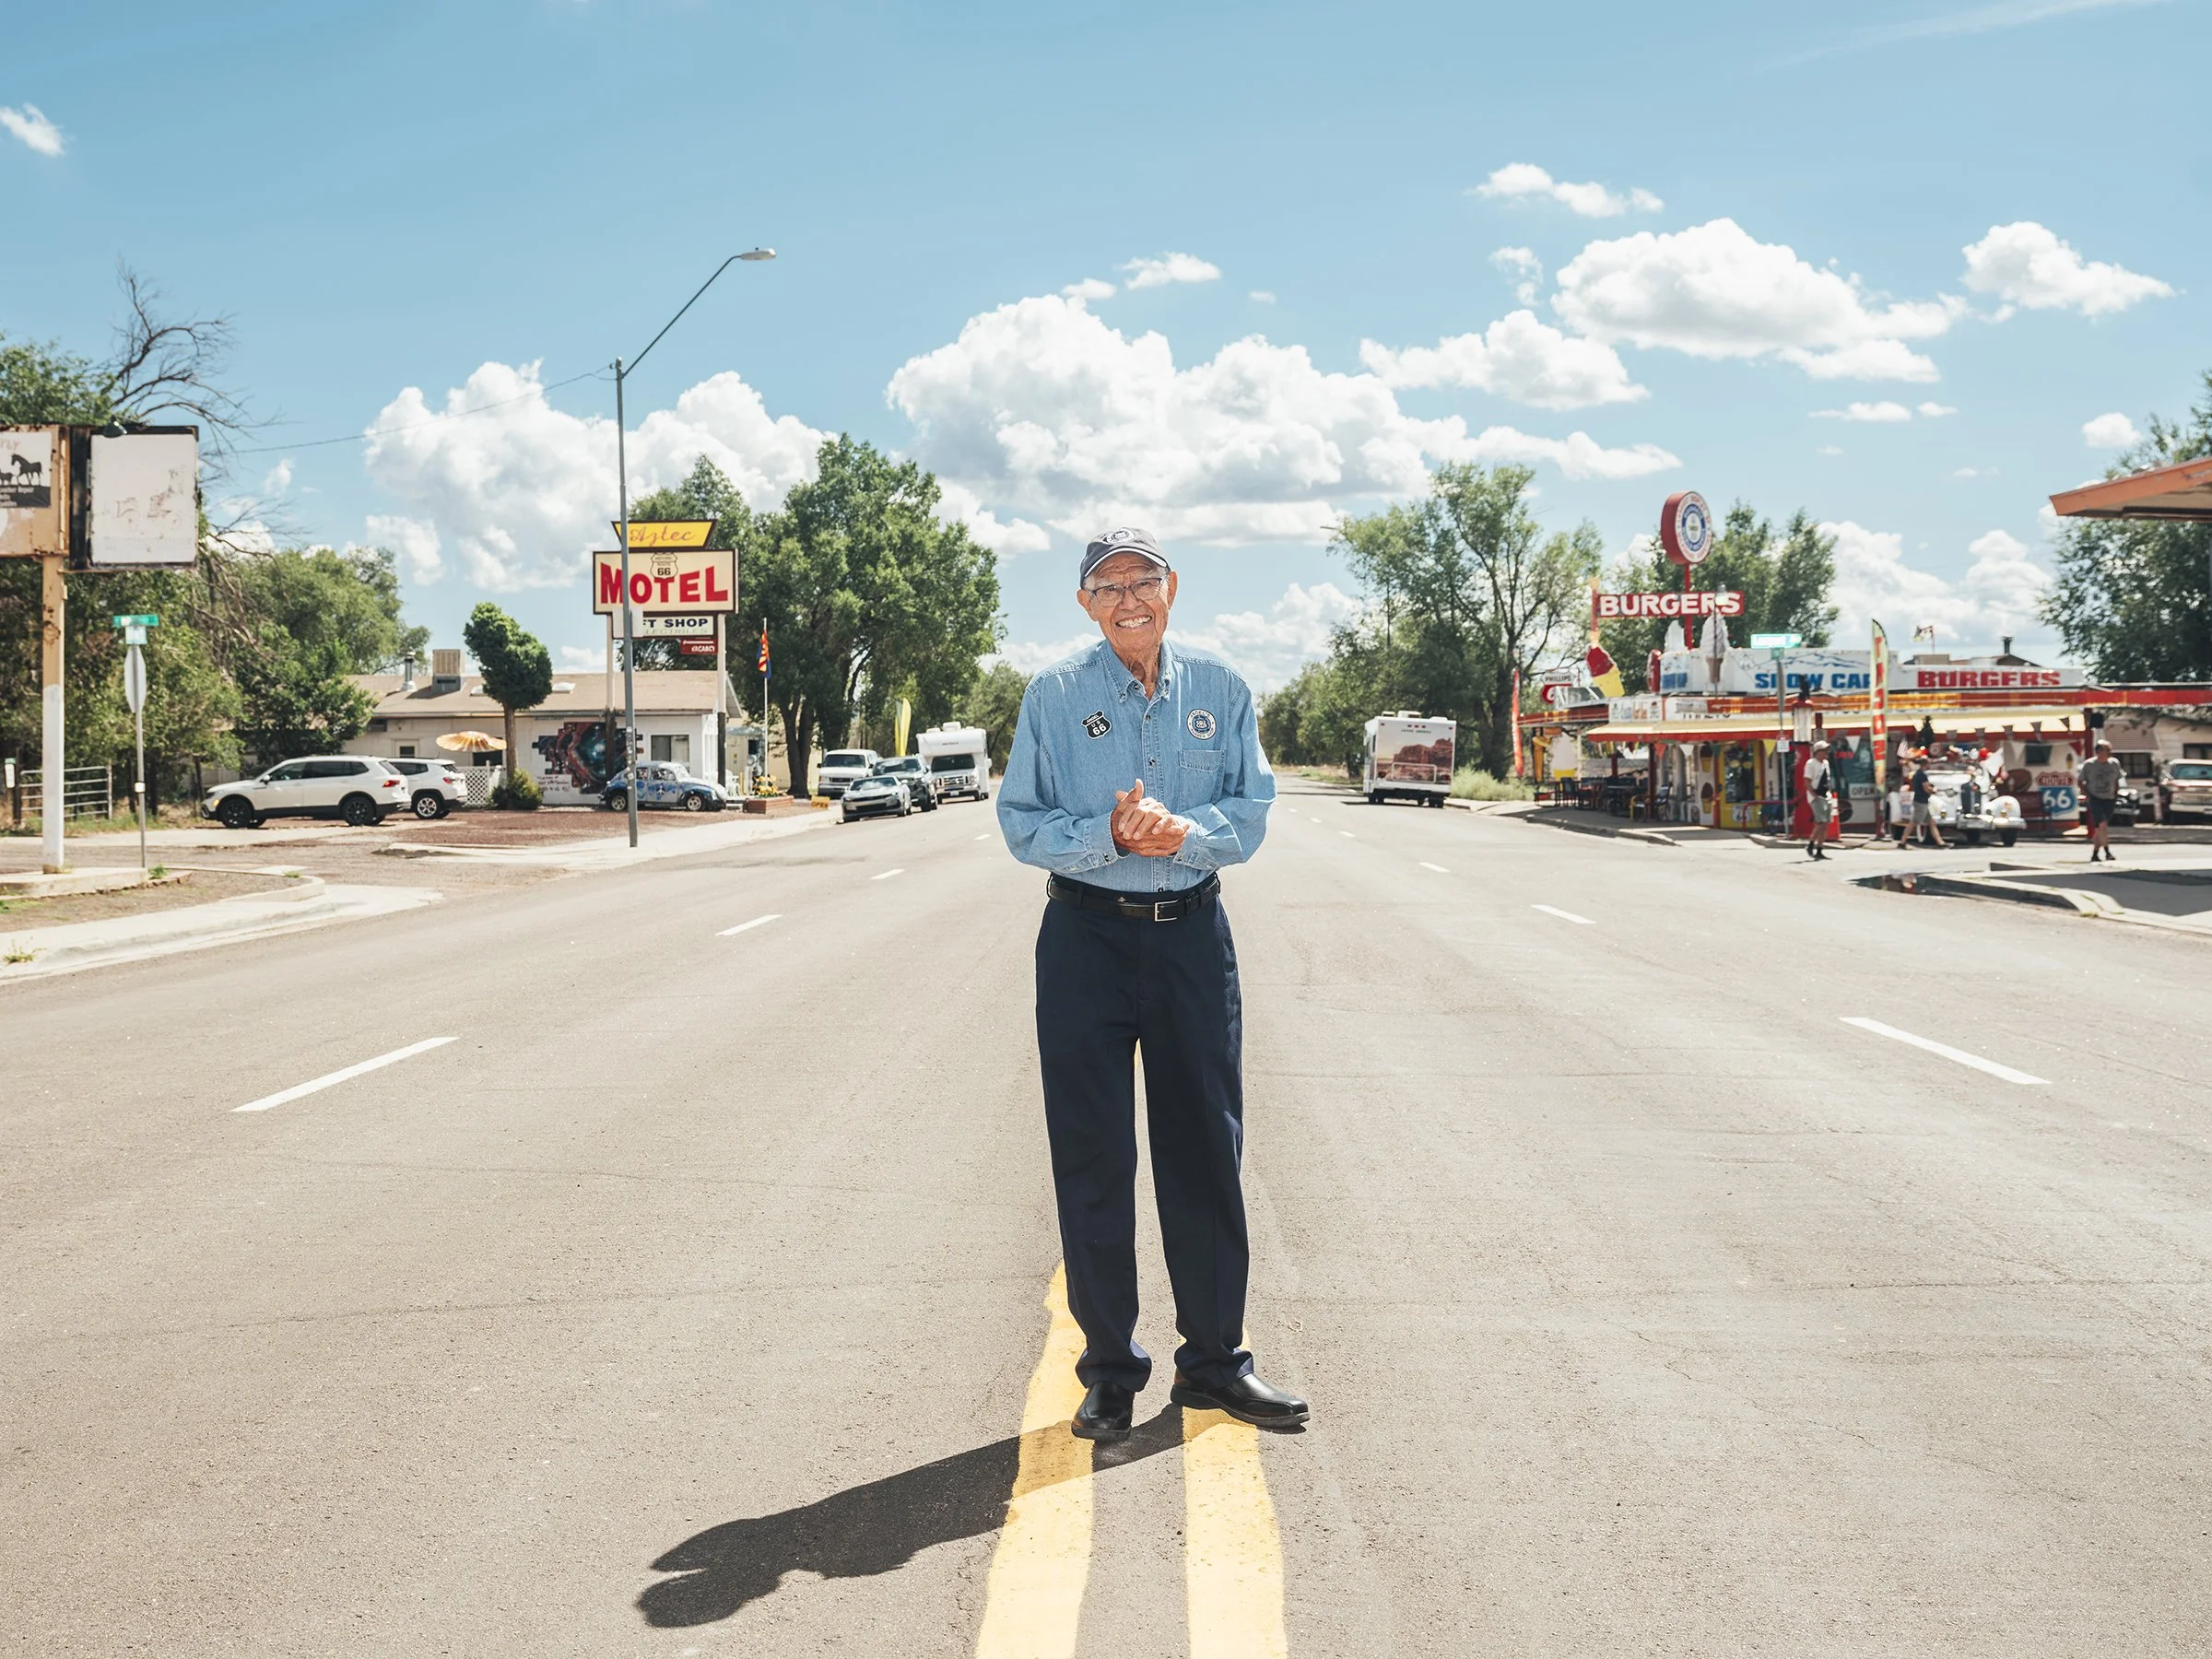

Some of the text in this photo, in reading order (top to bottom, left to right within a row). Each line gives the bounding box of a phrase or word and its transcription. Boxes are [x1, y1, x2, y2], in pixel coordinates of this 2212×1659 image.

[629, 525, 696, 547] Aztec
[657, 568, 671, 576] 66
[600, 562, 728, 604] MOTEL
[1599, 593, 1741, 617] BURGERS
[665, 618, 708, 628] SHOP
[1917, 671, 2061, 688] BURGERS
[1092, 724, 1107, 735] 66
[2042, 789, 2071, 809] 66
